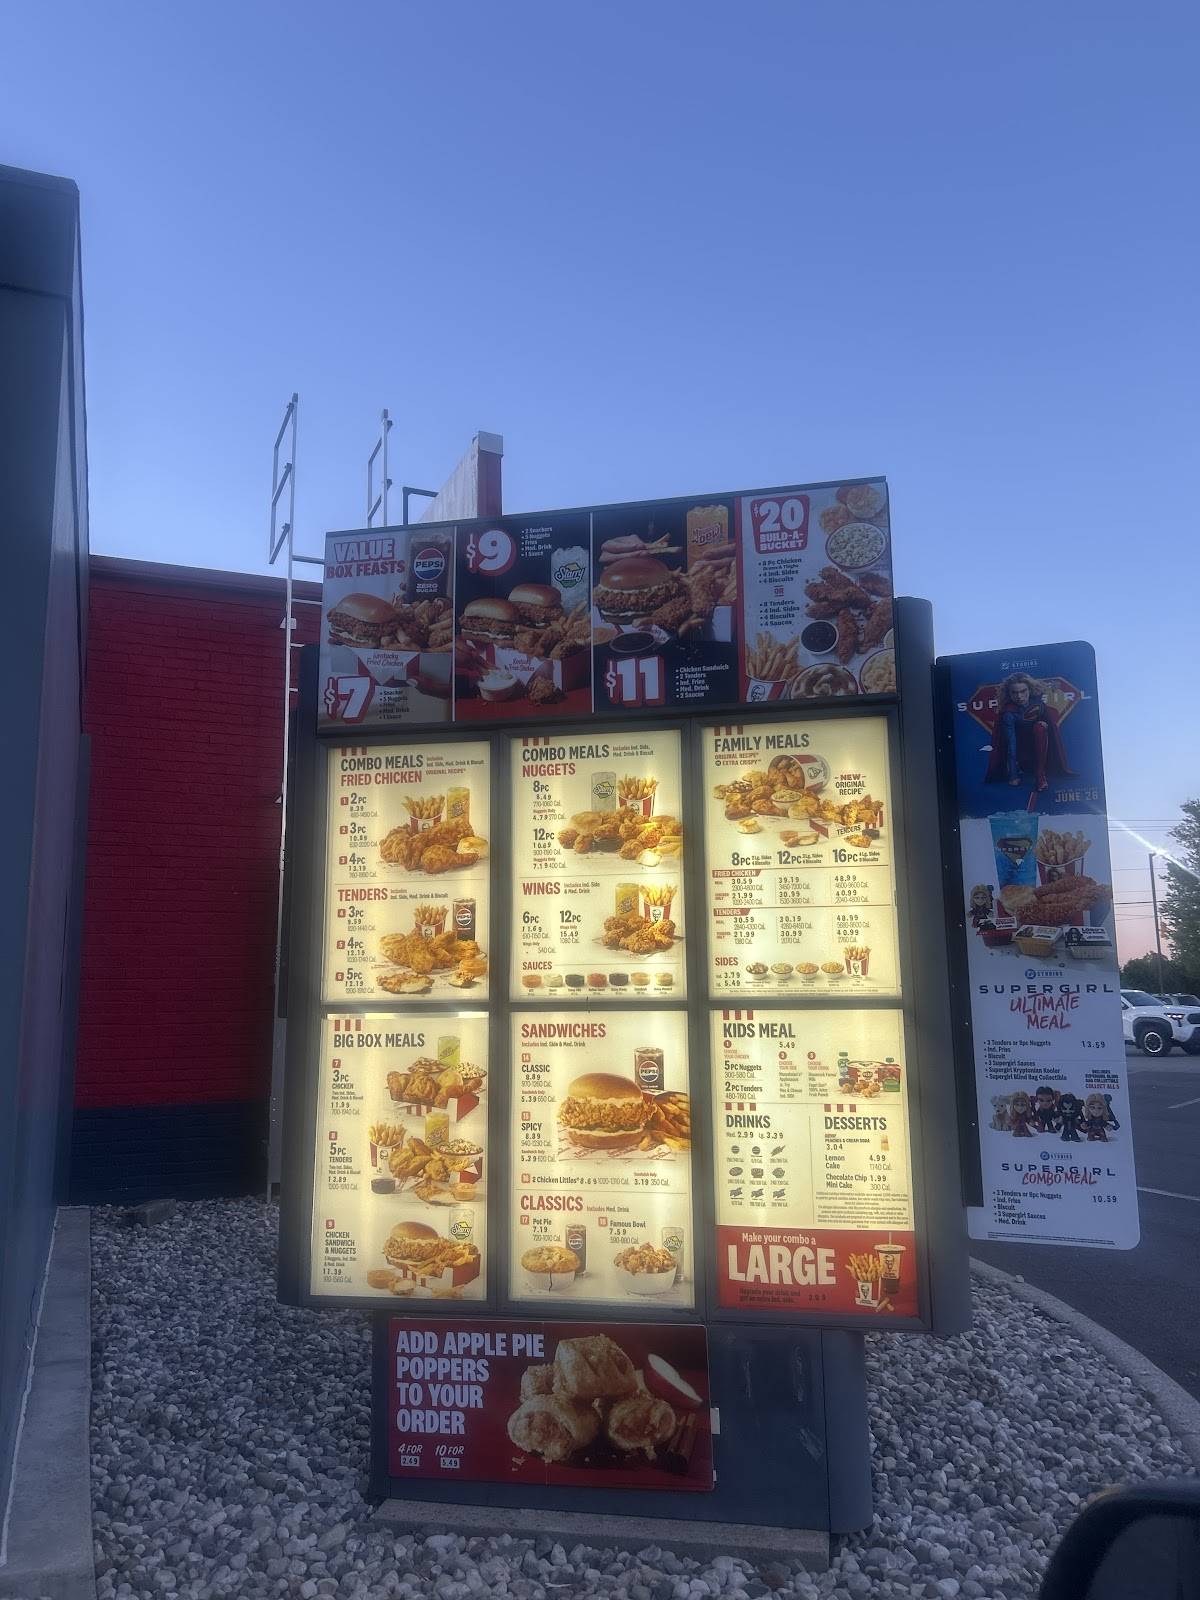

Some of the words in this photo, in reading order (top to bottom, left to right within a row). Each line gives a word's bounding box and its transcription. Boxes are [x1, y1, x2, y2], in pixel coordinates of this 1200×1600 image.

[334, 539, 395, 563] VALUE
[467, 530, 512, 571] $9
[760, 540, 804, 551] BUCKET
[326, 565, 355, 579] BOX
[356, 560, 406, 577] FEASTS
[416, 561, 444, 569] PEPSI
[606, 657, 660, 702] $11
[324, 677, 370, 720] $7
[714, 736, 762, 752] FAMILY
[765, 734, 810, 750] MEALS
[522, 747, 566, 762] COMBO
[570, 744, 610, 759] MEALS
[341, 757, 382, 772] COMBO
[385, 755, 424, 769] MEALS
[522, 763, 576, 778] NUGGETS
[341, 773, 372, 787] FRIED
[375, 771, 422, 784] CHICKEN
[836, 780, 866, 789] ORIGINAL
[1056, 792, 1081, 803] JUNE
[338, 888, 388, 902] TENDERS
[522, 882, 561, 896] WINGS
[522, 961, 552, 971] SAUCES
[715, 957, 738, 966] SIDES
[979, 984, 1114, 994] SUPERGIRL
[1010, 991, 1080, 1014] ULTIMATE
[1026, 1012, 1072, 1030] MEAL
[522, 1023, 606, 1039] SANDWICHES
[723, 1023, 756, 1038] KIDS
[759, 1024, 796, 1038] MEAL
[334, 1034, 354, 1048] BIG
[358, 1034, 382, 1048] BOX
[386, 1033, 425, 1048] MEALS
[522, 1064, 550, 1072] CLASSIC
[740, 1064, 762, 1072] Nuggets
[741, 1084, 762, 1092] Tenders
[522, 1122, 542, 1132] SPICY
[726, 1114, 770, 1128] DRINKS
[824, 1116, 887, 1130] DESSERTS
[1001, 1163, 1116, 1176] SUPERGIRL
[826, 1174, 854, 1182] Chocolate
[855, 1174, 868, 1182] Chip
[1022, 1172, 1062, 1186] COMBO
[1064, 1172, 1098, 1185] MEAL
[521, 1195, 584, 1212] CLASSICS
[1092, 1195, 1117, 1203] 10.59
[610, 1220, 632, 1228] Famous
[742, 1232, 762, 1242] Make
[763, 1234, 782, 1244] your
[783, 1234, 810, 1245] combo
[810, 1237, 816, 1246] a
[727, 1244, 836, 1286] LARGE
[396, 1331, 438, 1355] ADD
[444, 1332, 507, 1357] APPLE
[512, 1334, 545, 1358] PIE
[396, 1356, 490, 1382] POPPERS
[396, 1383, 423, 1406] TO
[428, 1384, 484, 1408] YOUR
[396, 1408, 465, 1435] ORDER
[398, 1443, 406, 1454] 4
[406, 1444, 423, 1454] FOR
[435, 1444, 448, 1456] 10
[448, 1446, 464, 1456] FOR
